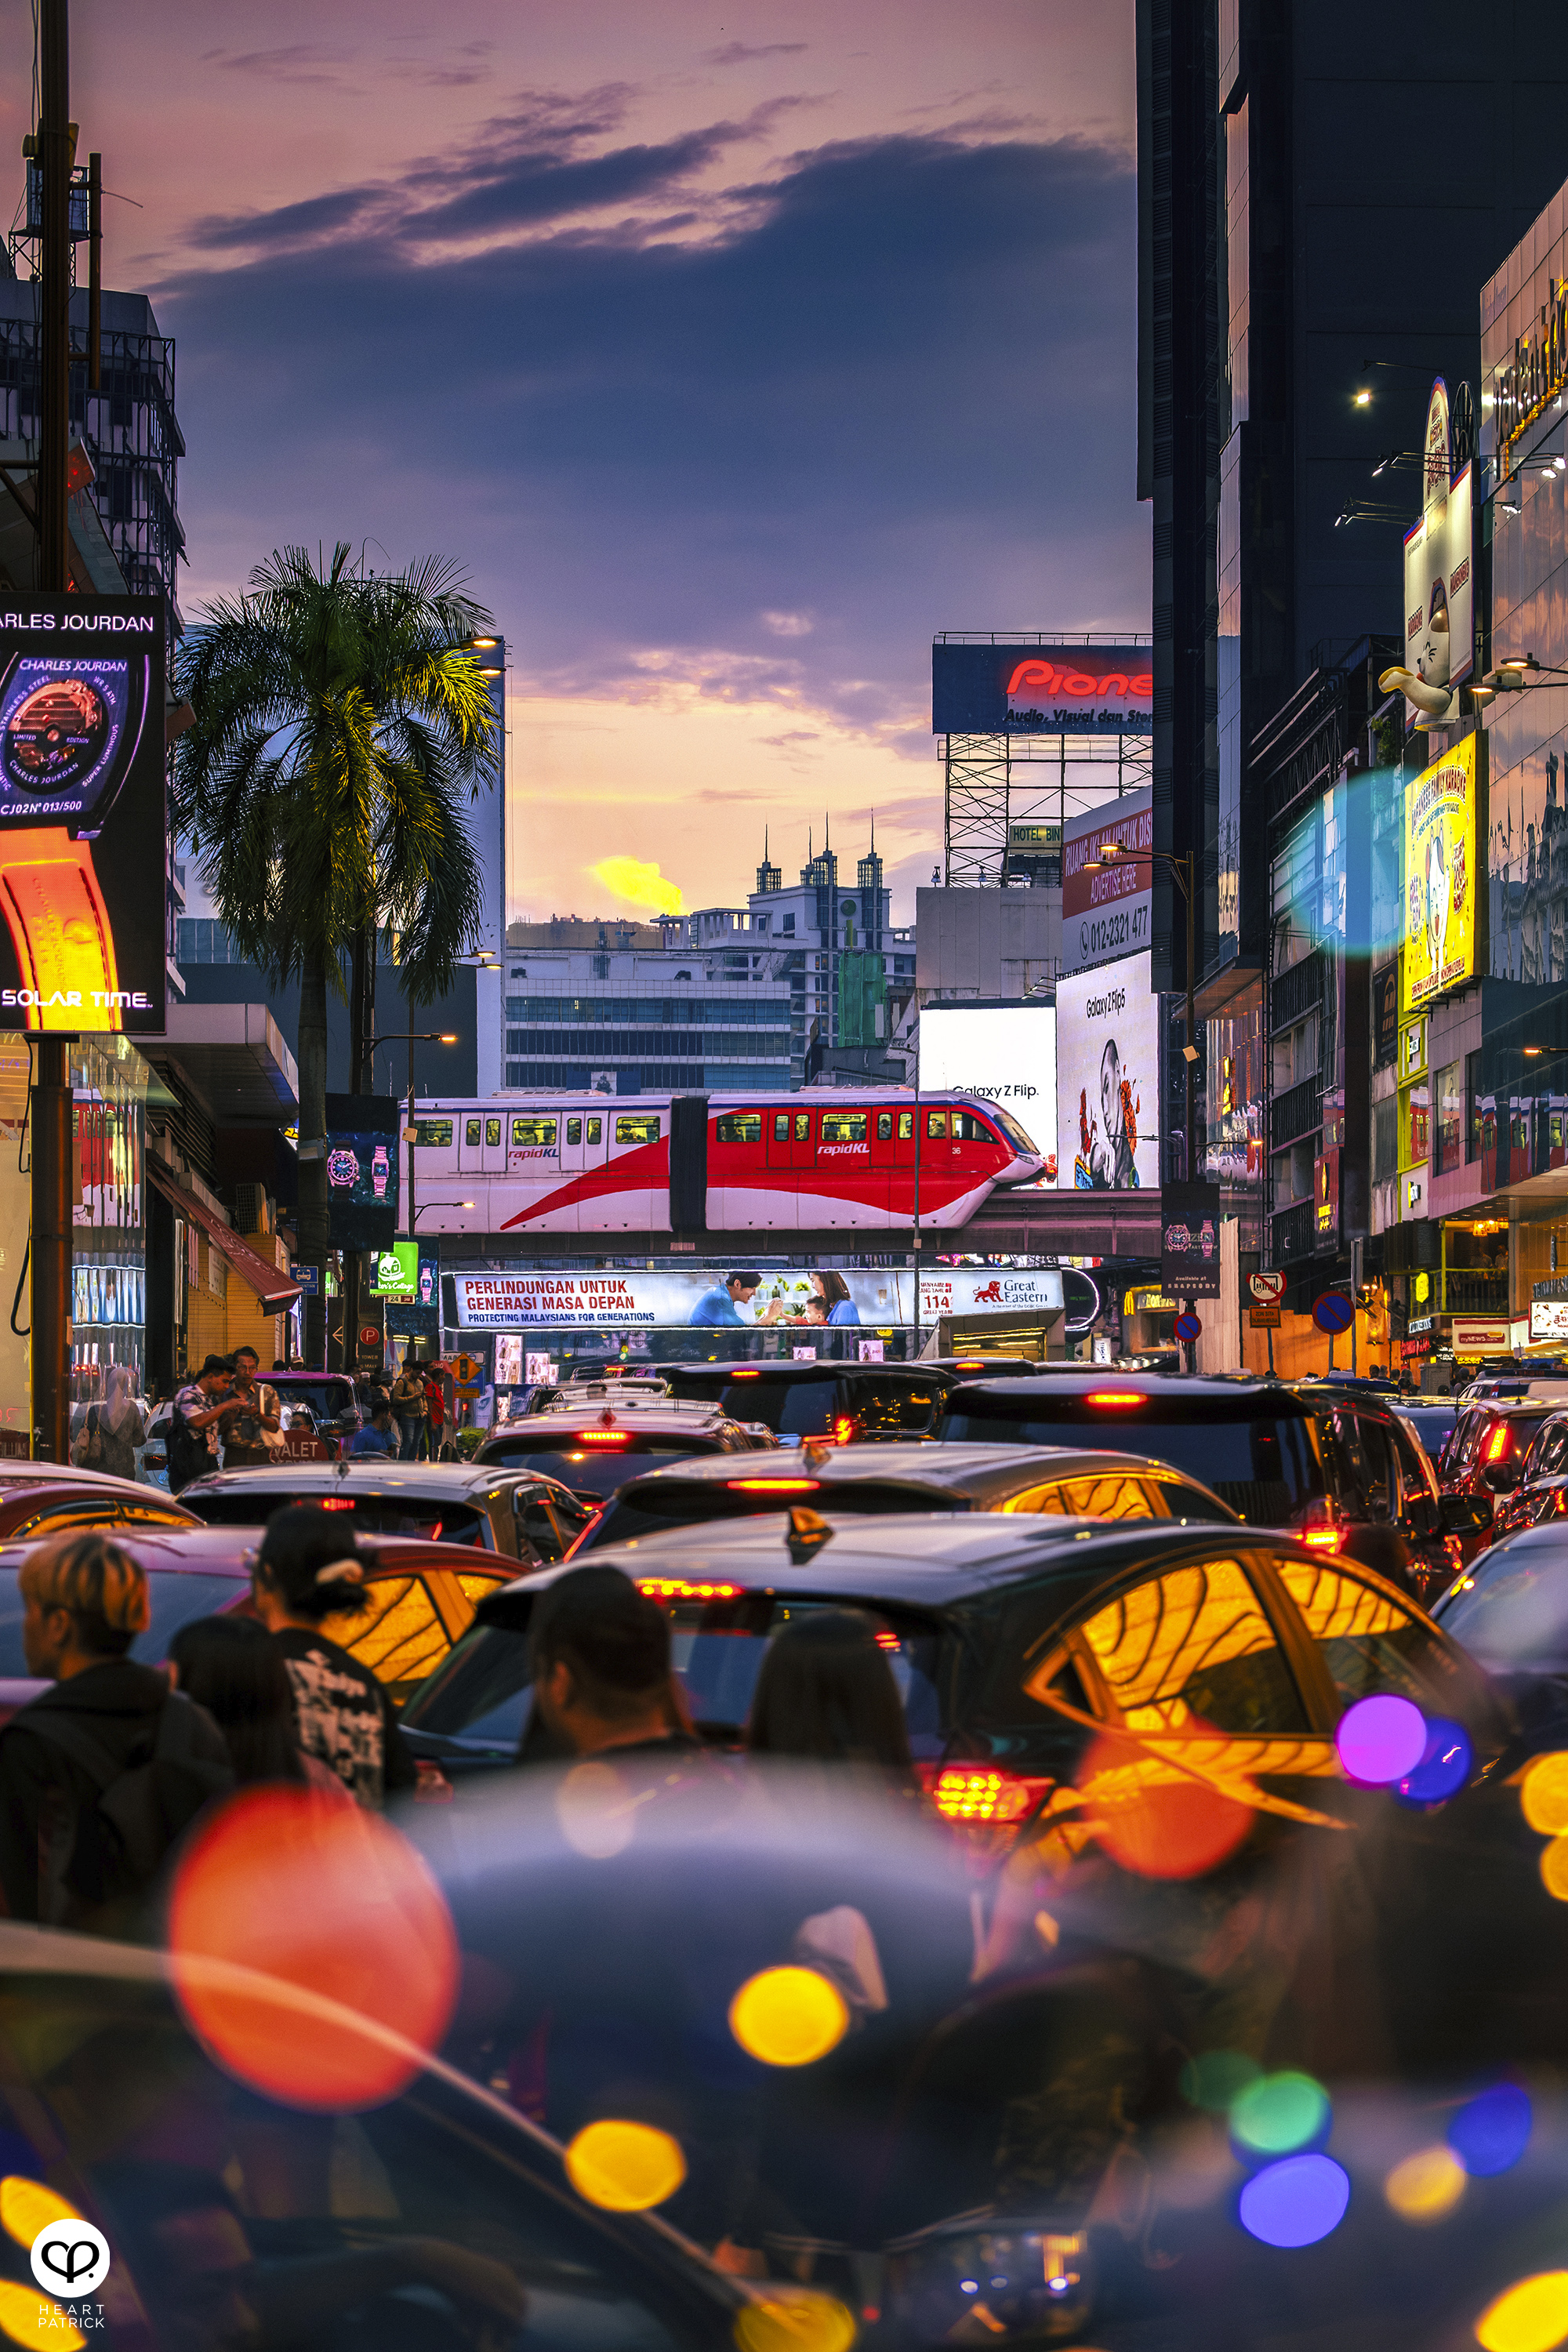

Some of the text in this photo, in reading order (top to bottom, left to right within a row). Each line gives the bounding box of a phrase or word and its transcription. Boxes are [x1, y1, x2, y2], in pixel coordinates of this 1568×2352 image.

[0, 613, 154, 631] RLES JOURDAN
[20, 660, 127, 672] CHARLES JOURDAN
[28, 675, 51, 691] STEEL
[1004, 709, 1049, 722] Audio,
[1053, 709, 1094, 721] Visual
[1098, 709, 1123, 722] dan
[82, 724, 119, 788] SUPER LUMINOUS
[9, 760, 78, 784] CHARLES JOURDAN
[1014, 827, 1042, 841] HOTEL
[1065, 838, 1088, 877] RUANG
[1091, 863, 1137, 905] ADVERTISE HERE
[1091, 905, 1148, 953] 012-2321 477
[2, 989, 147, 1008] SOLAR TIME
[1087, 988, 1126, 1018] Galaxy Z Flip5
[1004, 1085, 1011, 1096] Z
[508, 1149, 560, 1160] rapidKL
[817, 1143, 870, 1156] rapidKL
[465, 1280, 627, 1294] PERLINDUNGAN UNTUK
[1004, 1279, 1036, 1291] Great
[466, 1296, 635, 1310] GENERASI MASA DEPAN
[1004, 1292, 1048, 1303] Eastern
[468, 1313, 519, 1323] PROTECTING
[521, 1313, 575, 1322] MALAYSIANS
[597, 1312, 655, 1321] GENERATIONS
